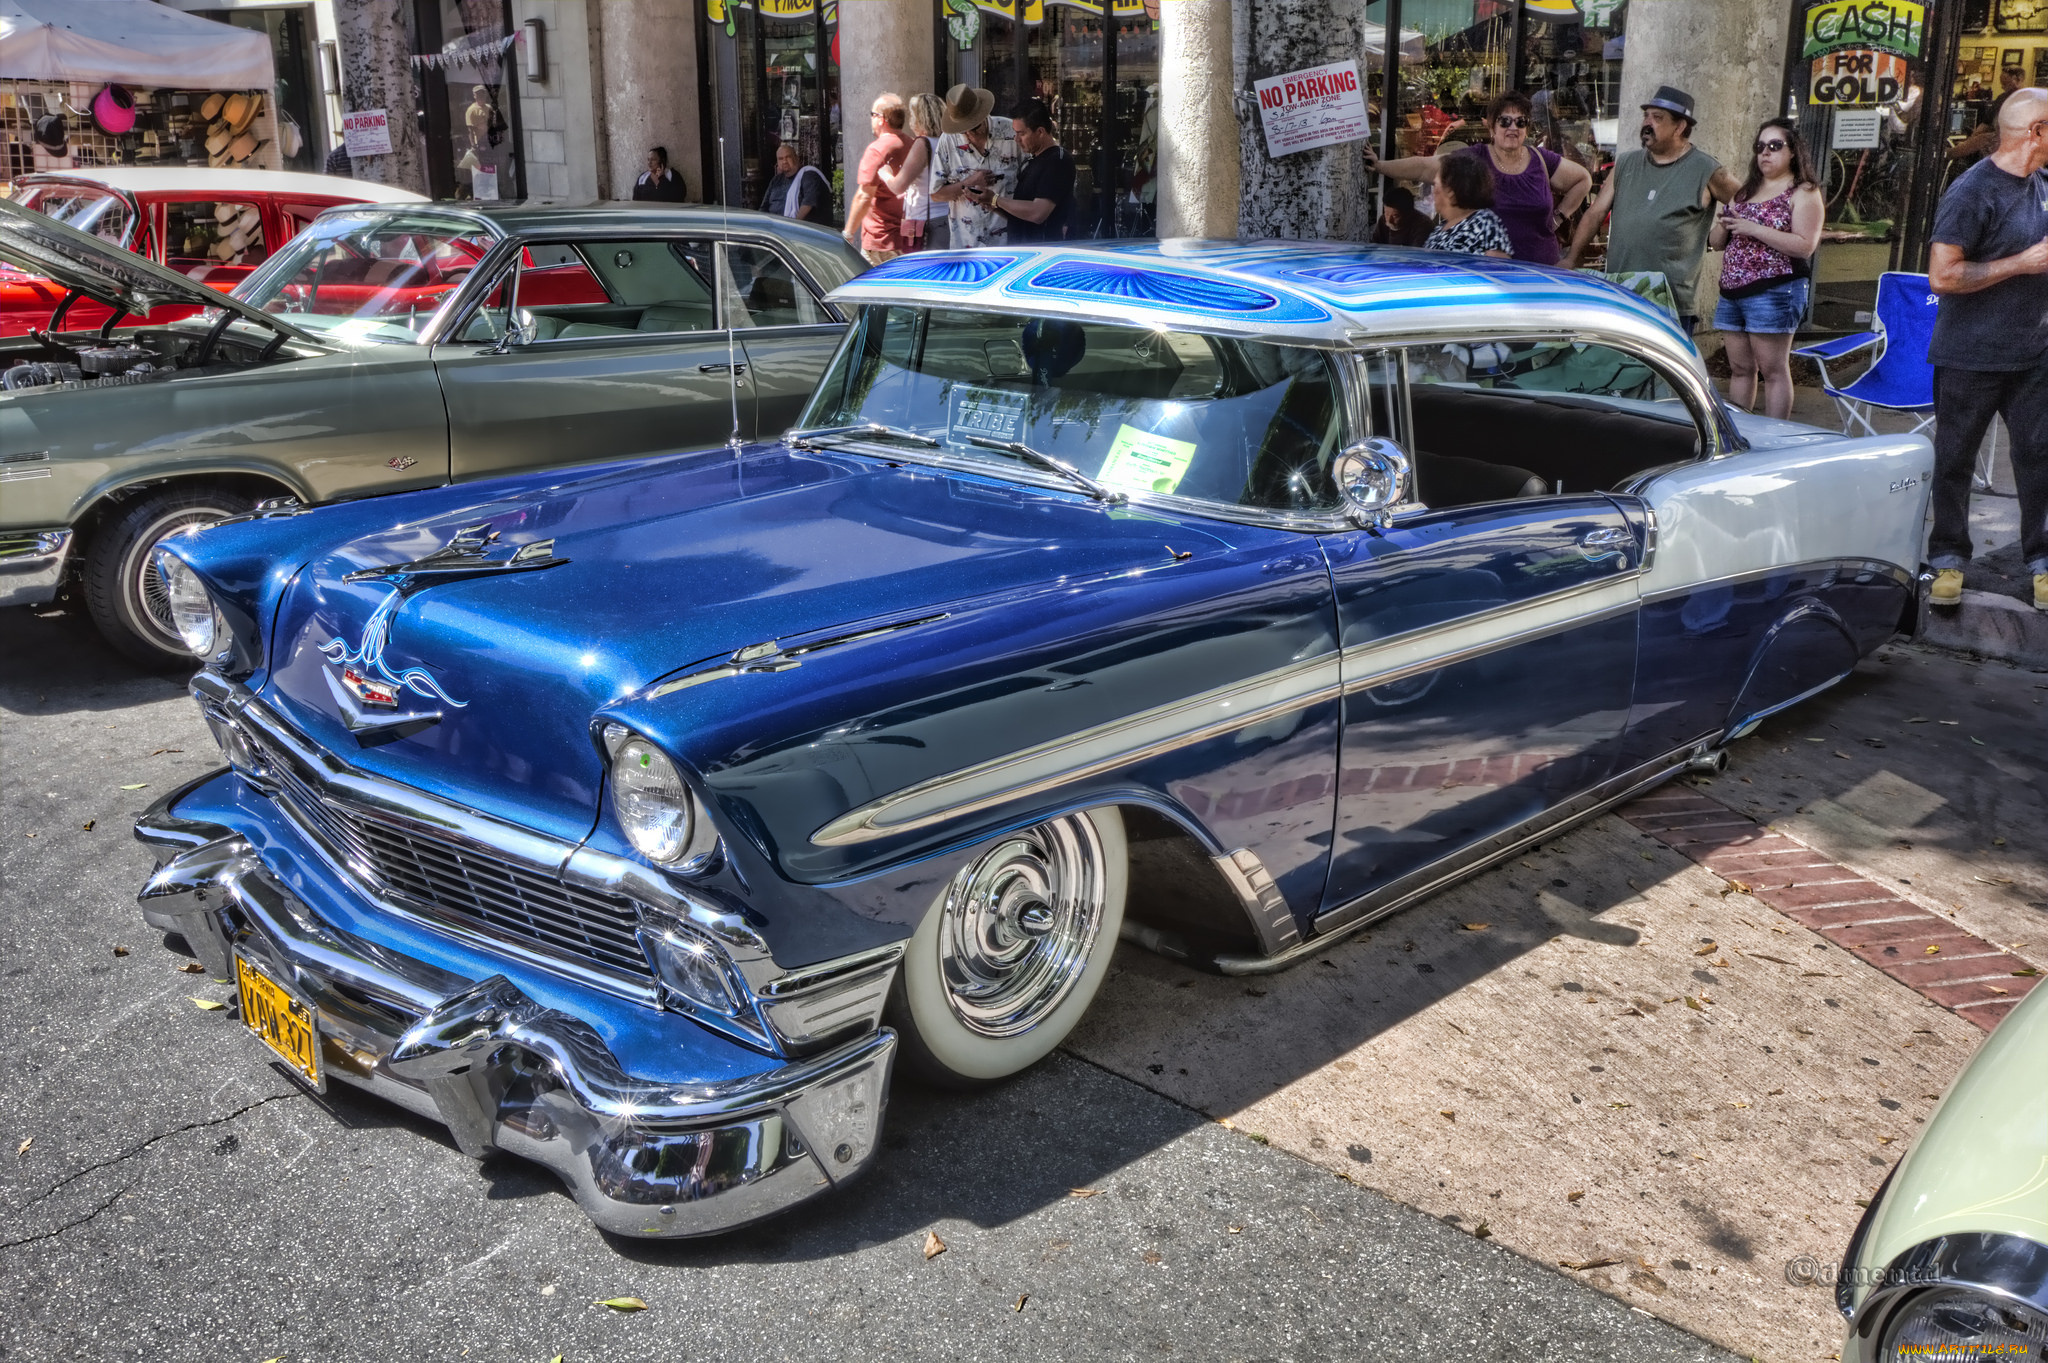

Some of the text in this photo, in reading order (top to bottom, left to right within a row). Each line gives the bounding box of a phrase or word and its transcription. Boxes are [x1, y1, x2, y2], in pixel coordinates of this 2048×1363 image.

[1835, 54, 1873, 75] FOR
[1282, 68, 1329, 84] EMERGENCY
[1260, 70, 1357, 110] NO PARKING
[1814, 76, 1899, 102] GOLD
[1281, 94, 1342, 112] TOW-AWAY ZONE
[343, 118, 353, 130] NO
[354, 114, 386, 129] PARKING
[957, 407, 1019, 434] TRIBE
